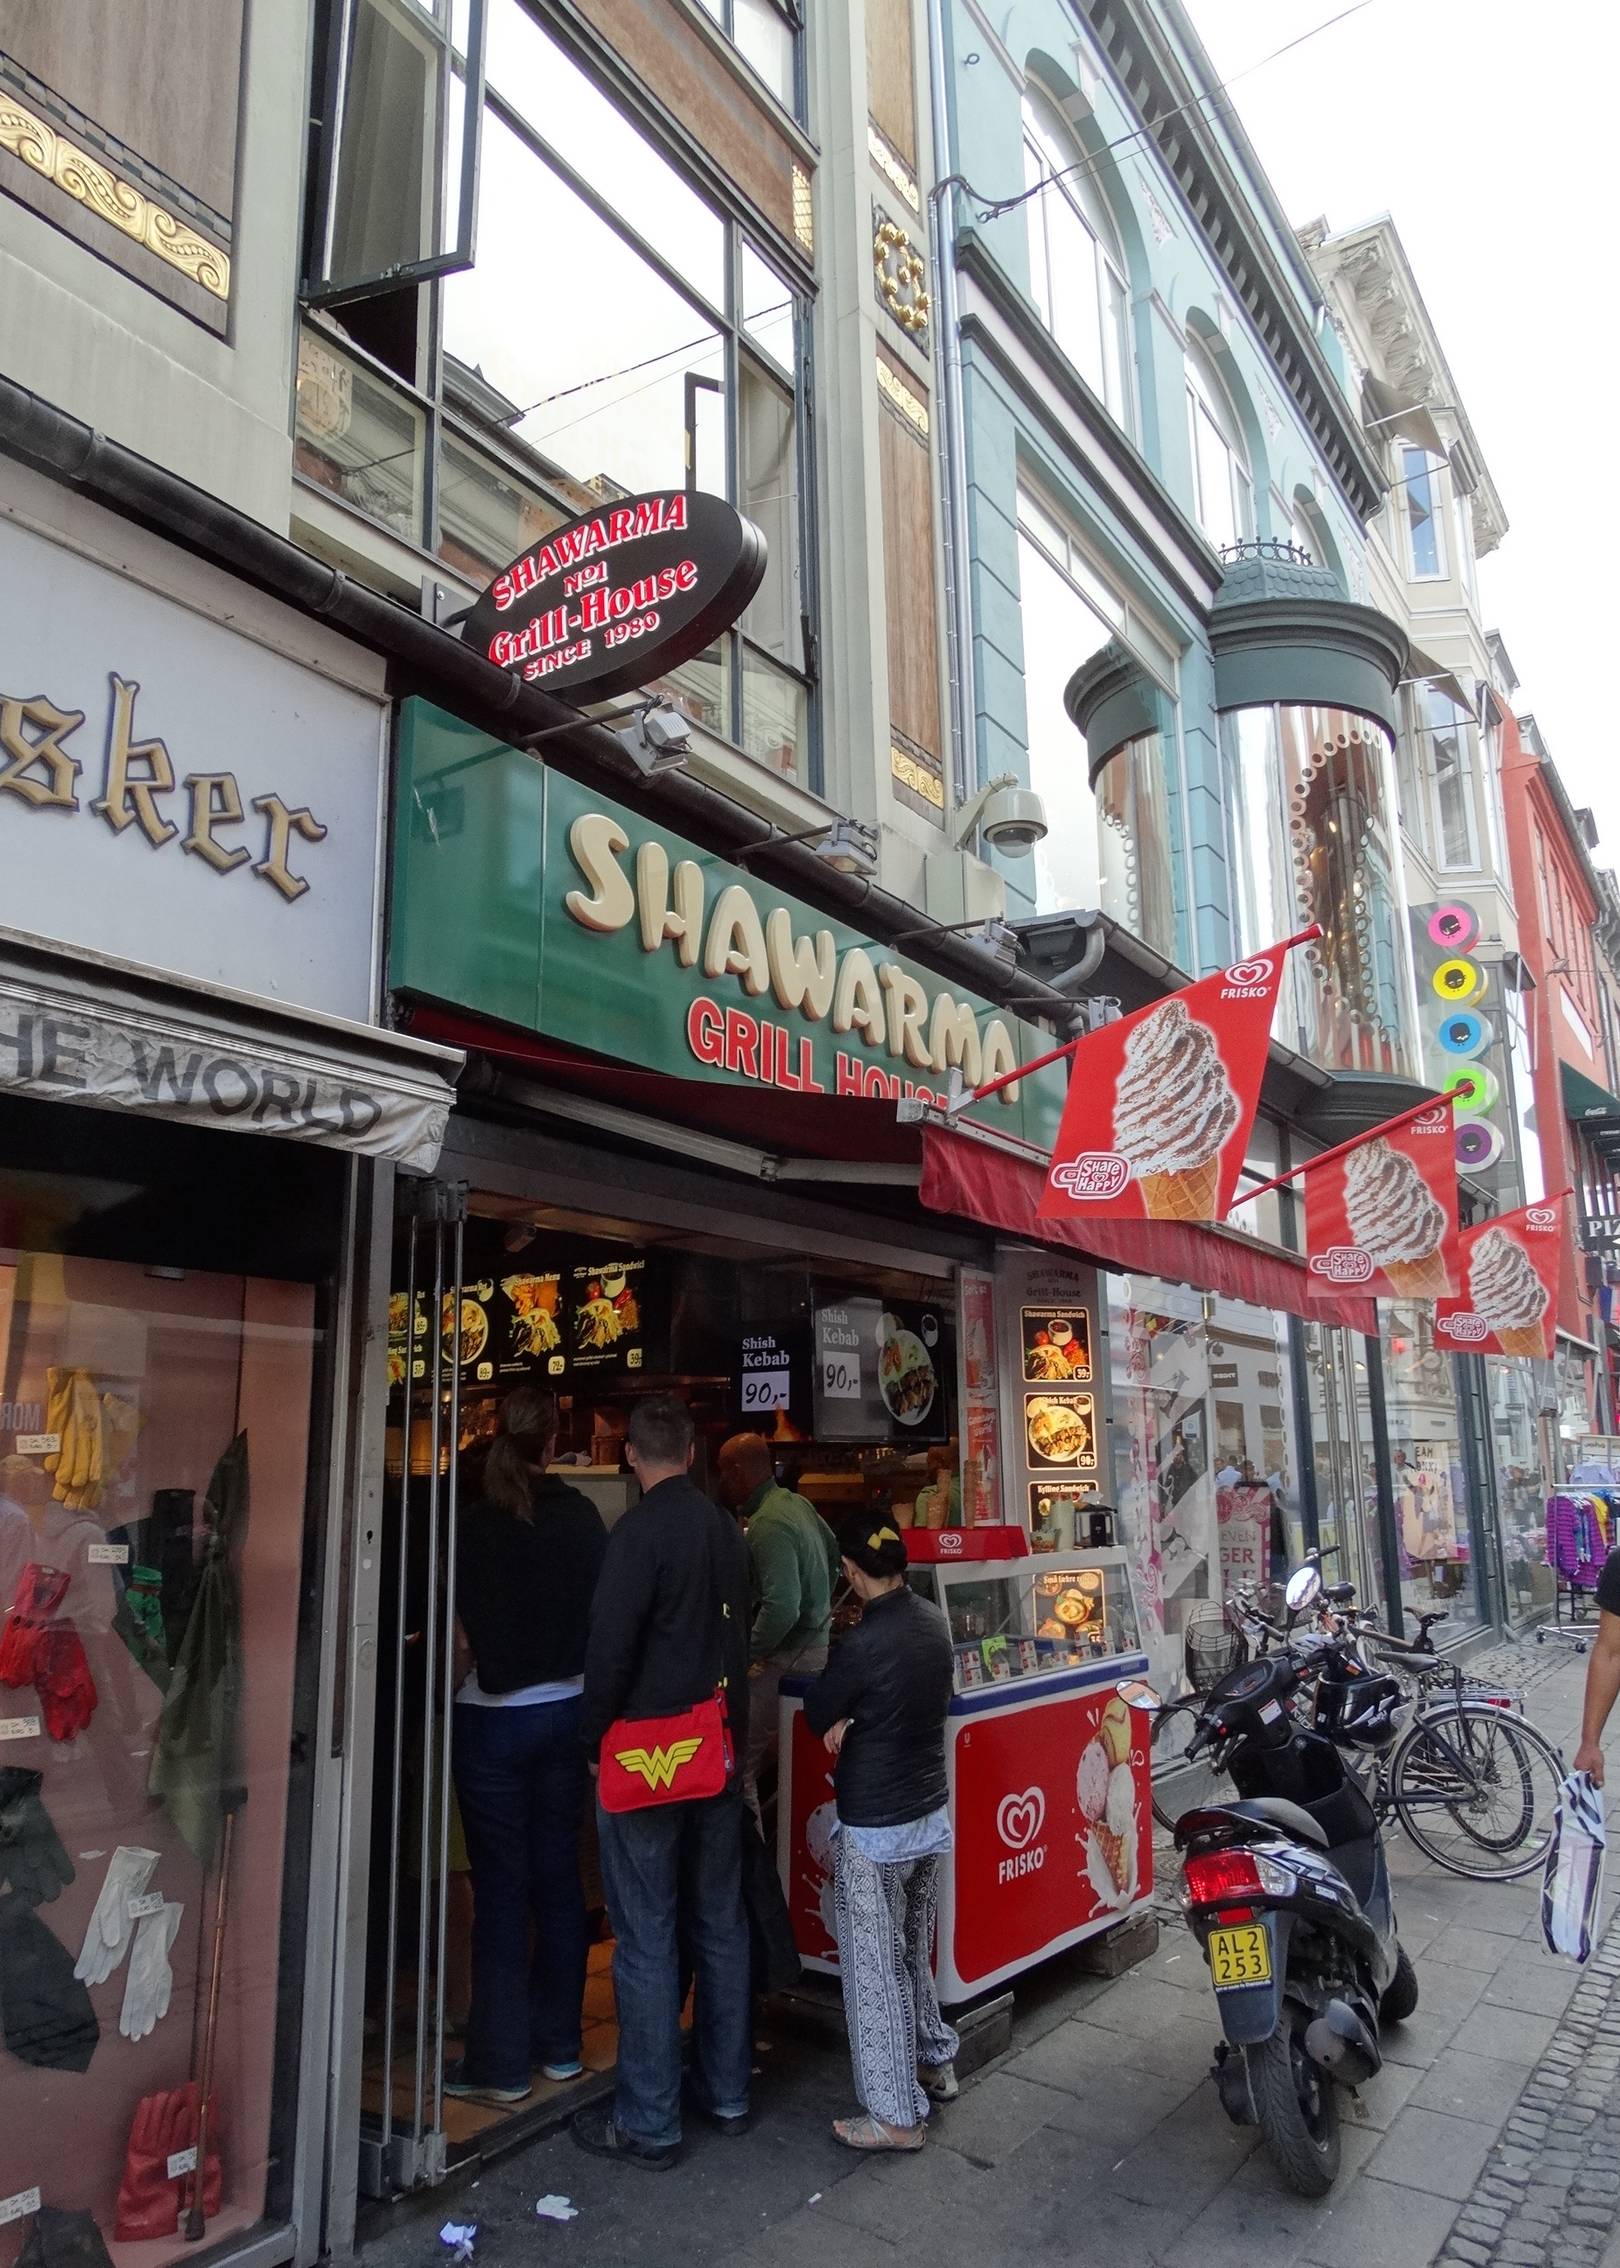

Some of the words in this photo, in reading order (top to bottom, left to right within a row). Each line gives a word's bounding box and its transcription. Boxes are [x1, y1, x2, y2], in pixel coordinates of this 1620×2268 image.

[491, 493, 689, 611] SHAWARMA
[488, 559, 698, 668] Grill-House
[522, 639, 591, 682] SINCE
[565, 813, 1019, 1105] SHAWARMA
[1220, 986, 1268, 999] FRISKO
[687, 995, 825, 1095] GRILL
[132, 1037, 385, 1138] WORLD
[1411, 1125, 1447, 1135] FRISKO
[820, 1308, 848, 1325] Shish
[742, 1336, 776, 1350] Shish
[822, 1327, 859, 1346] Kebab
[742, 1350, 790, 1367] Kebab
[998, 1846, 1044, 1885] FRISKO
[1219, 1954, 1262, 1980] 253
